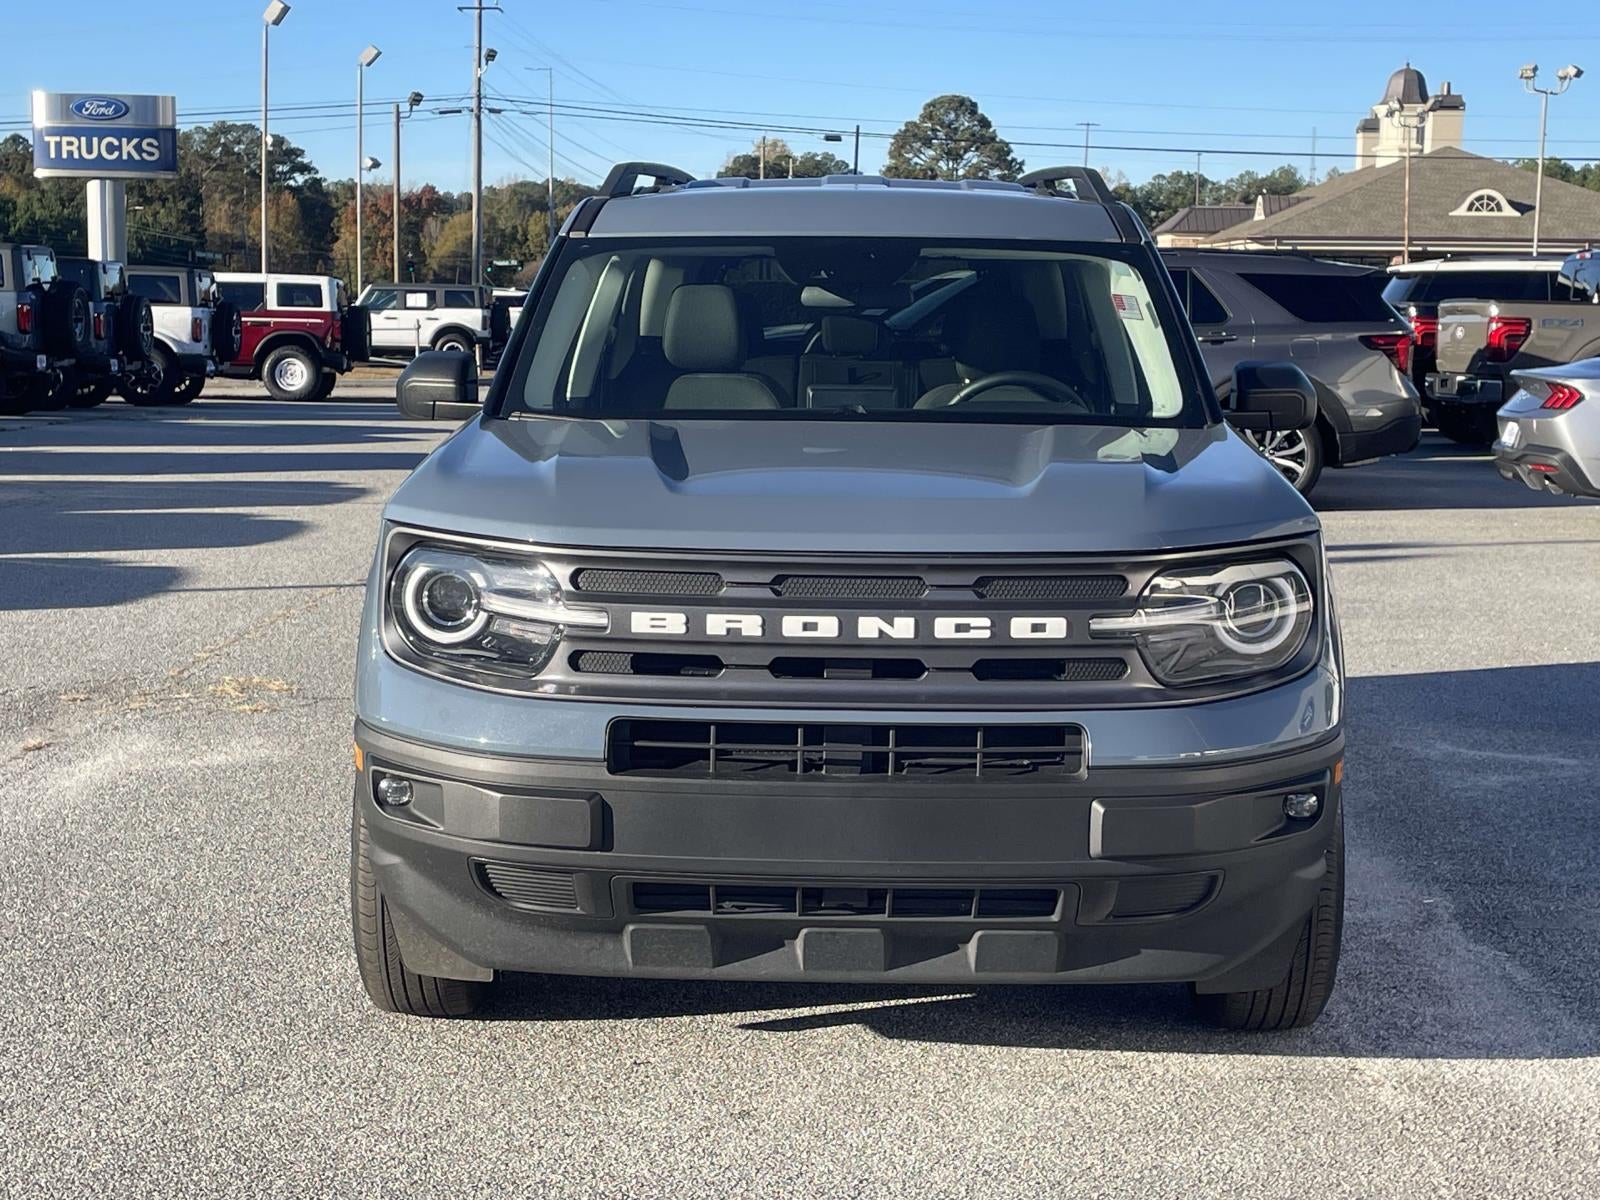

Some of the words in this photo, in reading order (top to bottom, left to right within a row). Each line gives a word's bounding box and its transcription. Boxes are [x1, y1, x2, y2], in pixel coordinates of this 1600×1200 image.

[82, 101, 116, 116] Ford
[43, 136, 160, 161] TRUCKS
[630, 611, 1068, 640] BRONCO
